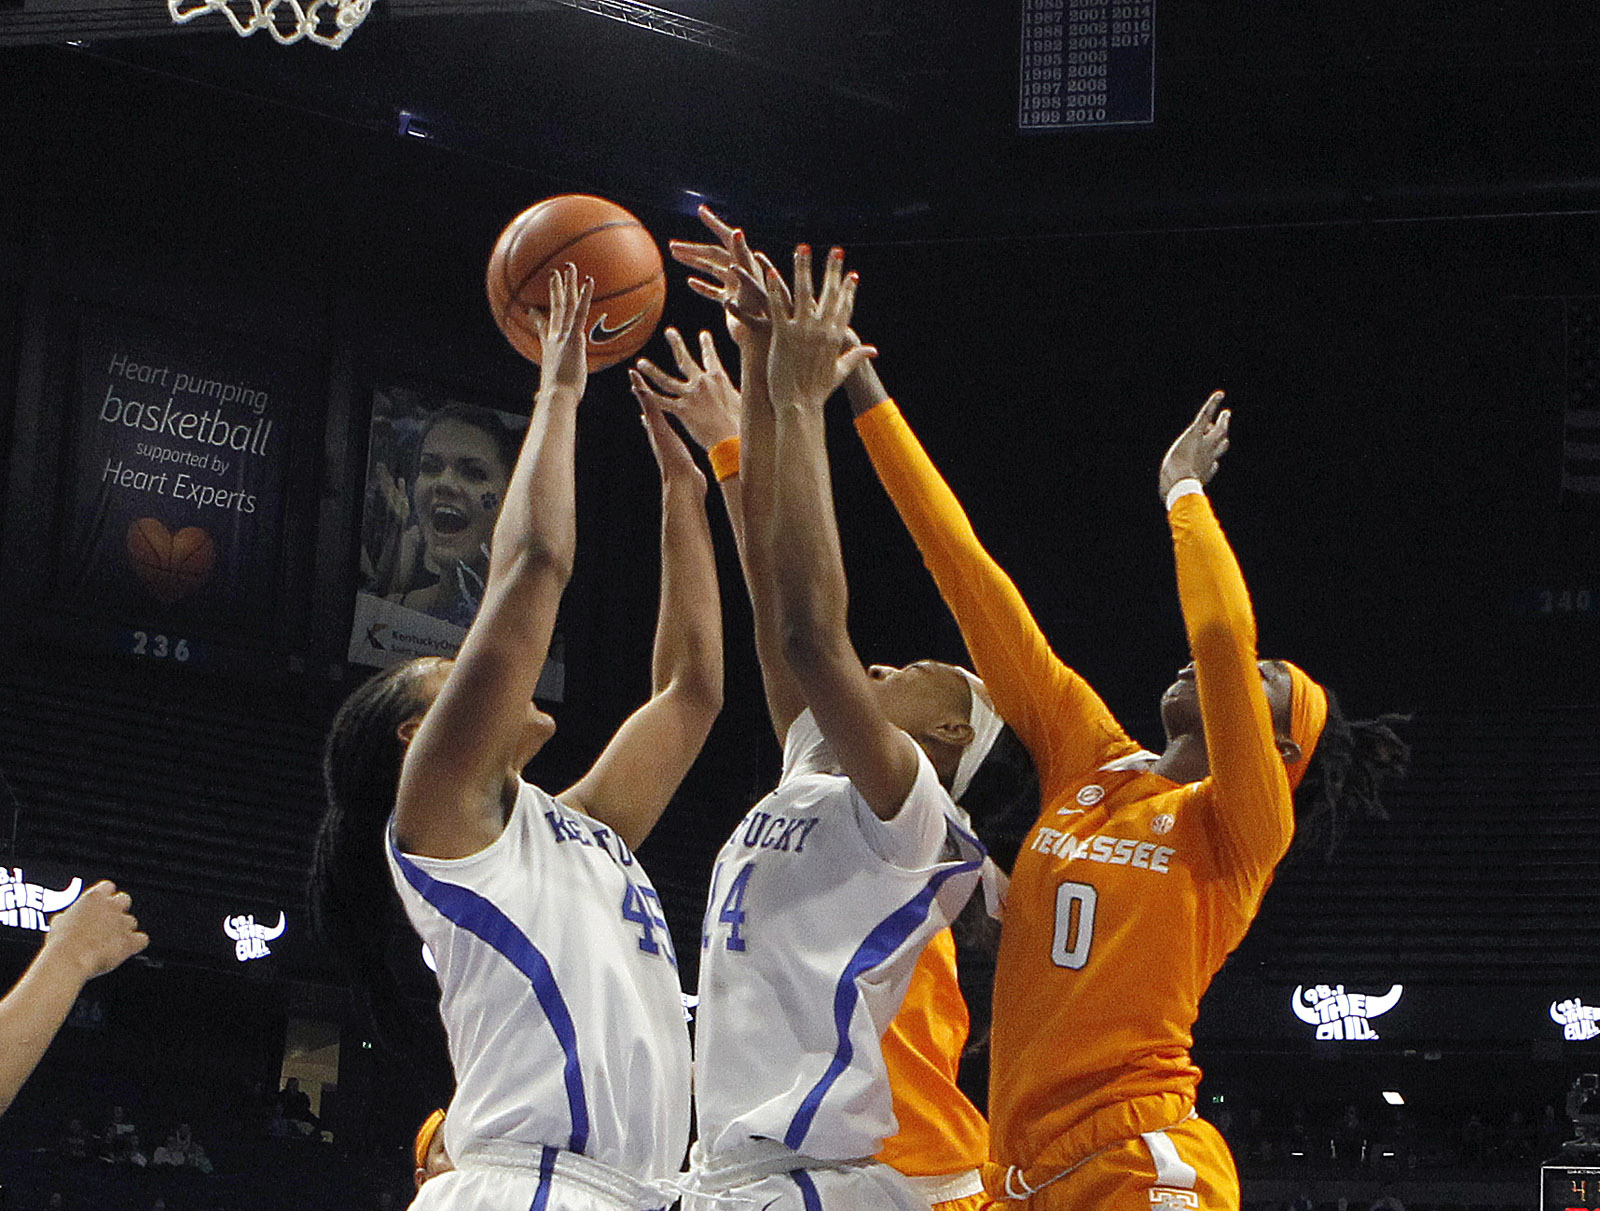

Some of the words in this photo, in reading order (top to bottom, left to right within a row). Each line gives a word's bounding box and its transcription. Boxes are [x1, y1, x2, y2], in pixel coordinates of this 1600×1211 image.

[1069, 9, 1107, 22] 2001
[1112, 6, 1151, 19] 2014
[1069, 22, 1107, 36] 2002
[1112, 20, 1150, 34] 2016
[1111, 34, 1150, 47] 2017
[1068, 64, 1107, 78] 2006
[1023, 96, 1061, 110] 1998
[1067, 94, 1107, 107] 2009
[1022, 110, 1060, 124] 1999
[1066, 109, 1106, 122] 2010
[108, 353, 170, 387] Heart
[171, 372, 268, 415] pumping
[99, 384, 273, 456] basketball
[136, 442, 210, 469] supported
[210, 454, 230, 476] by
[102, 458, 169, 495] Heart
[172, 473, 257, 513] Experts
[133, 631, 190, 662] 236
[1051, 880, 1099, 971] 0
[1303, 984, 1345, 1005] 98.1
[1314, 993, 1367, 1024] THE
